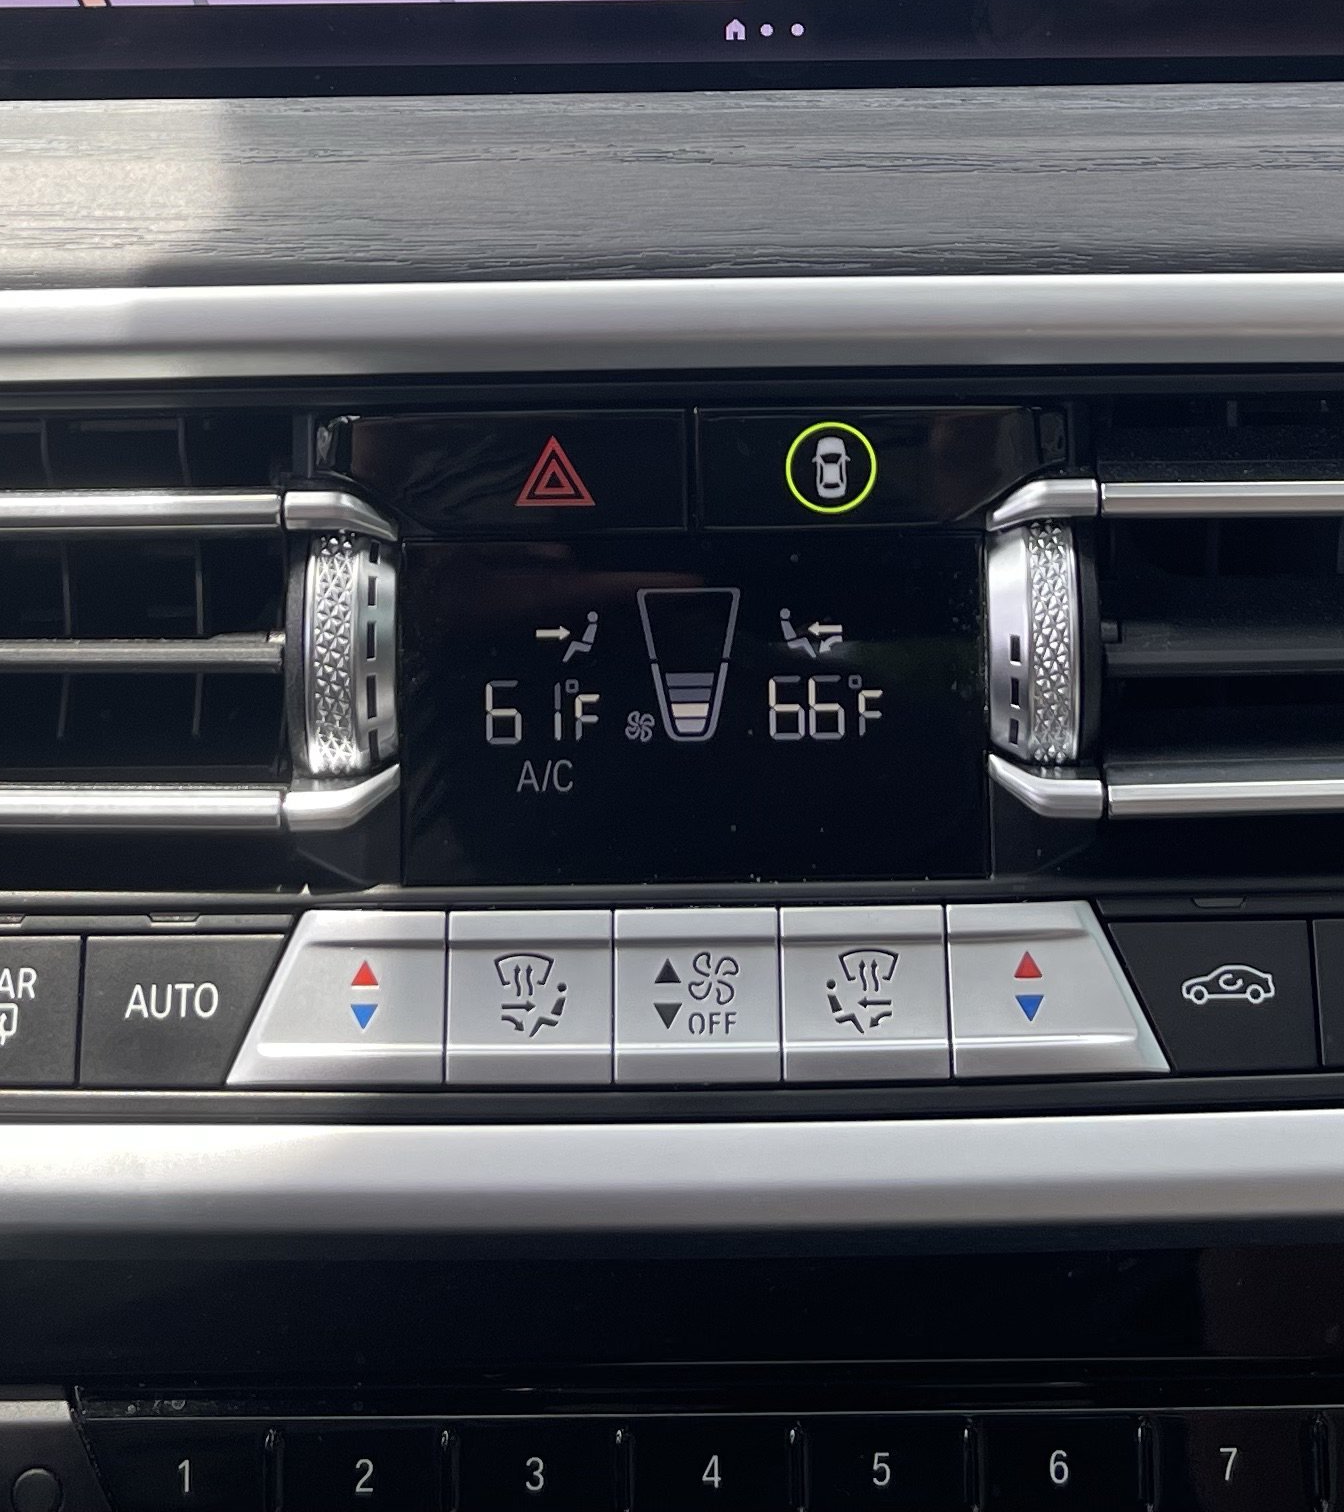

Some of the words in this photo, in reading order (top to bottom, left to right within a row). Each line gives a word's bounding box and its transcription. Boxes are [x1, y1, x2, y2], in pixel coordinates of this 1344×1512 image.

[516, 759, 574, 793] A/C
[124, 982, 219, 1020] AUTO
[687, 1010, 738, 1036] OFF
[178, 1459, 190, 1493] 1
[355, 1458, 374, 1493] 2
[525, 1456, 544, 1491] 3
[701, 1454, 722, 1489] 4
[872, 1452, 891, 1486] 5
[1049, 1449, 1069, 1484] 6
[1219, 1447, 1238, 1481] 7
